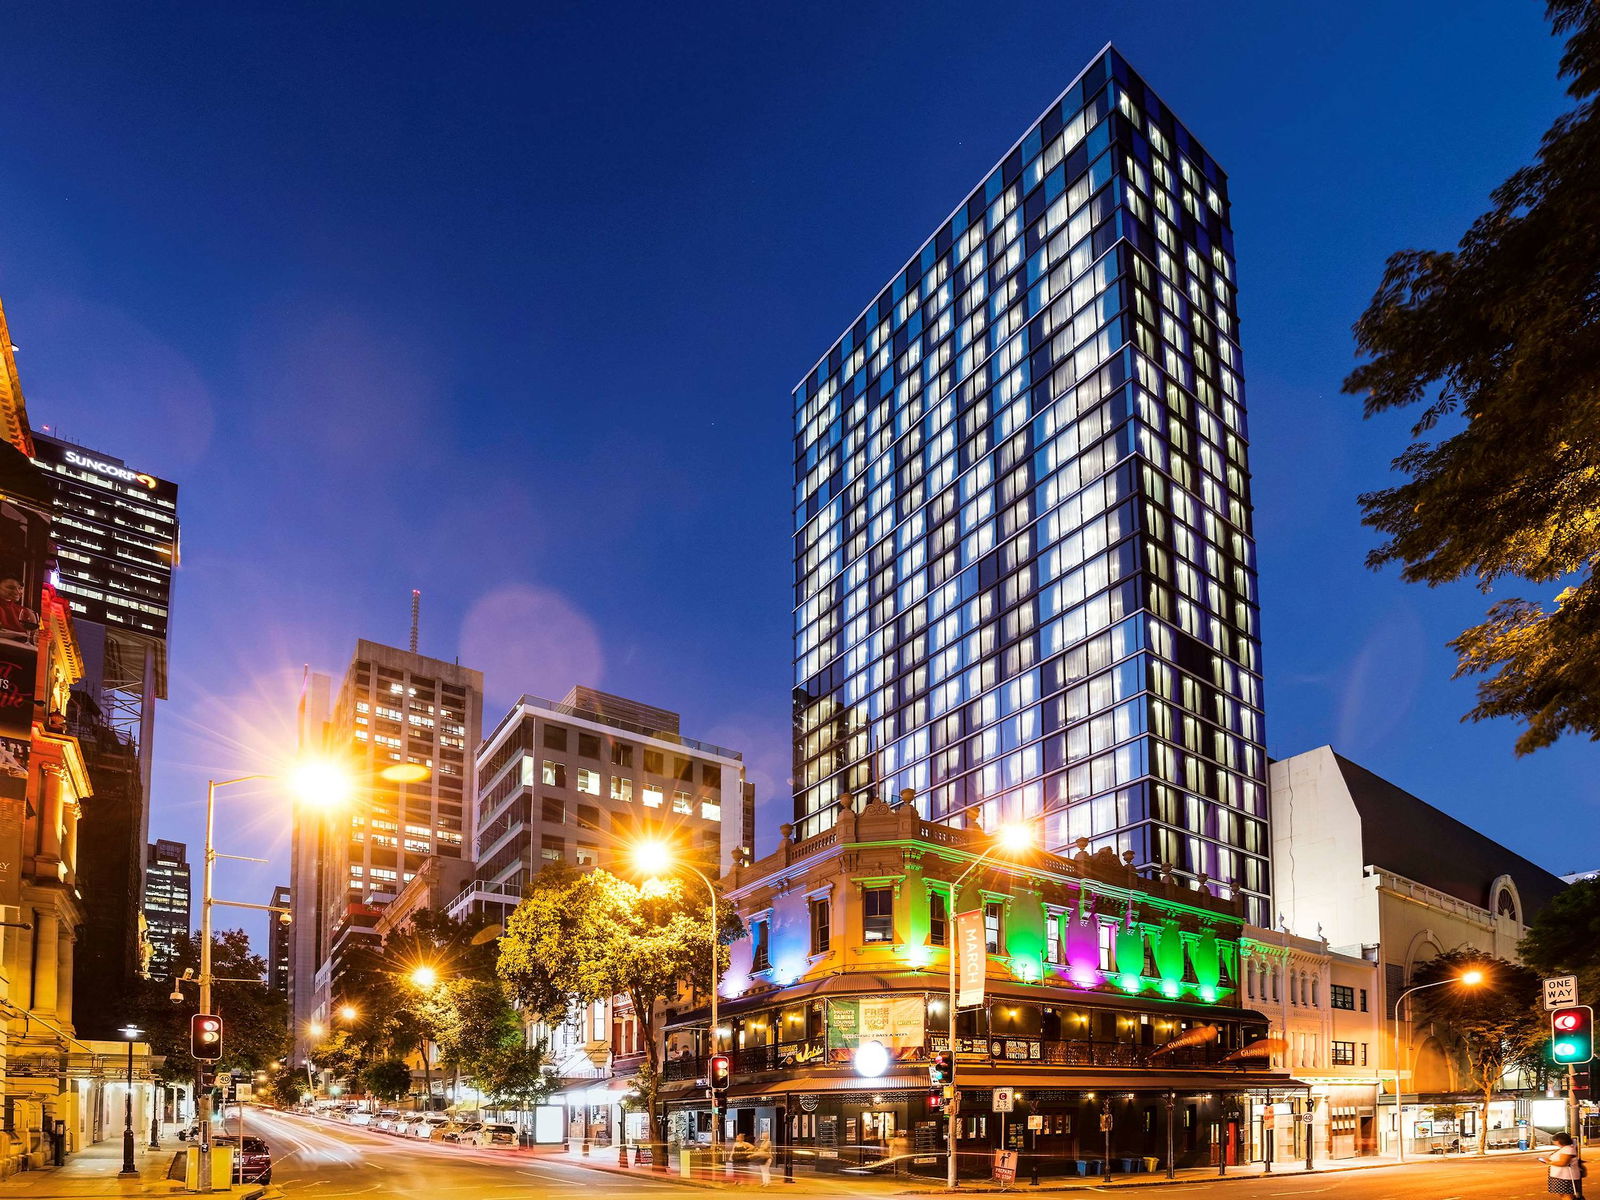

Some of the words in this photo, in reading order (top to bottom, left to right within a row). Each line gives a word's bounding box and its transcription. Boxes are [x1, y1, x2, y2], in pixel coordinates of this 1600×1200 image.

[65, 451, 136, 481] SUNCORP
[965, 927, 979, 985] MARCH
[1548, 980, 1571, 989] ONE
[1547, 988, 1573, 998] WAY
[864, 1008, 889, 1016] FREE
[931, 1037, 945, 1046] LIVE
